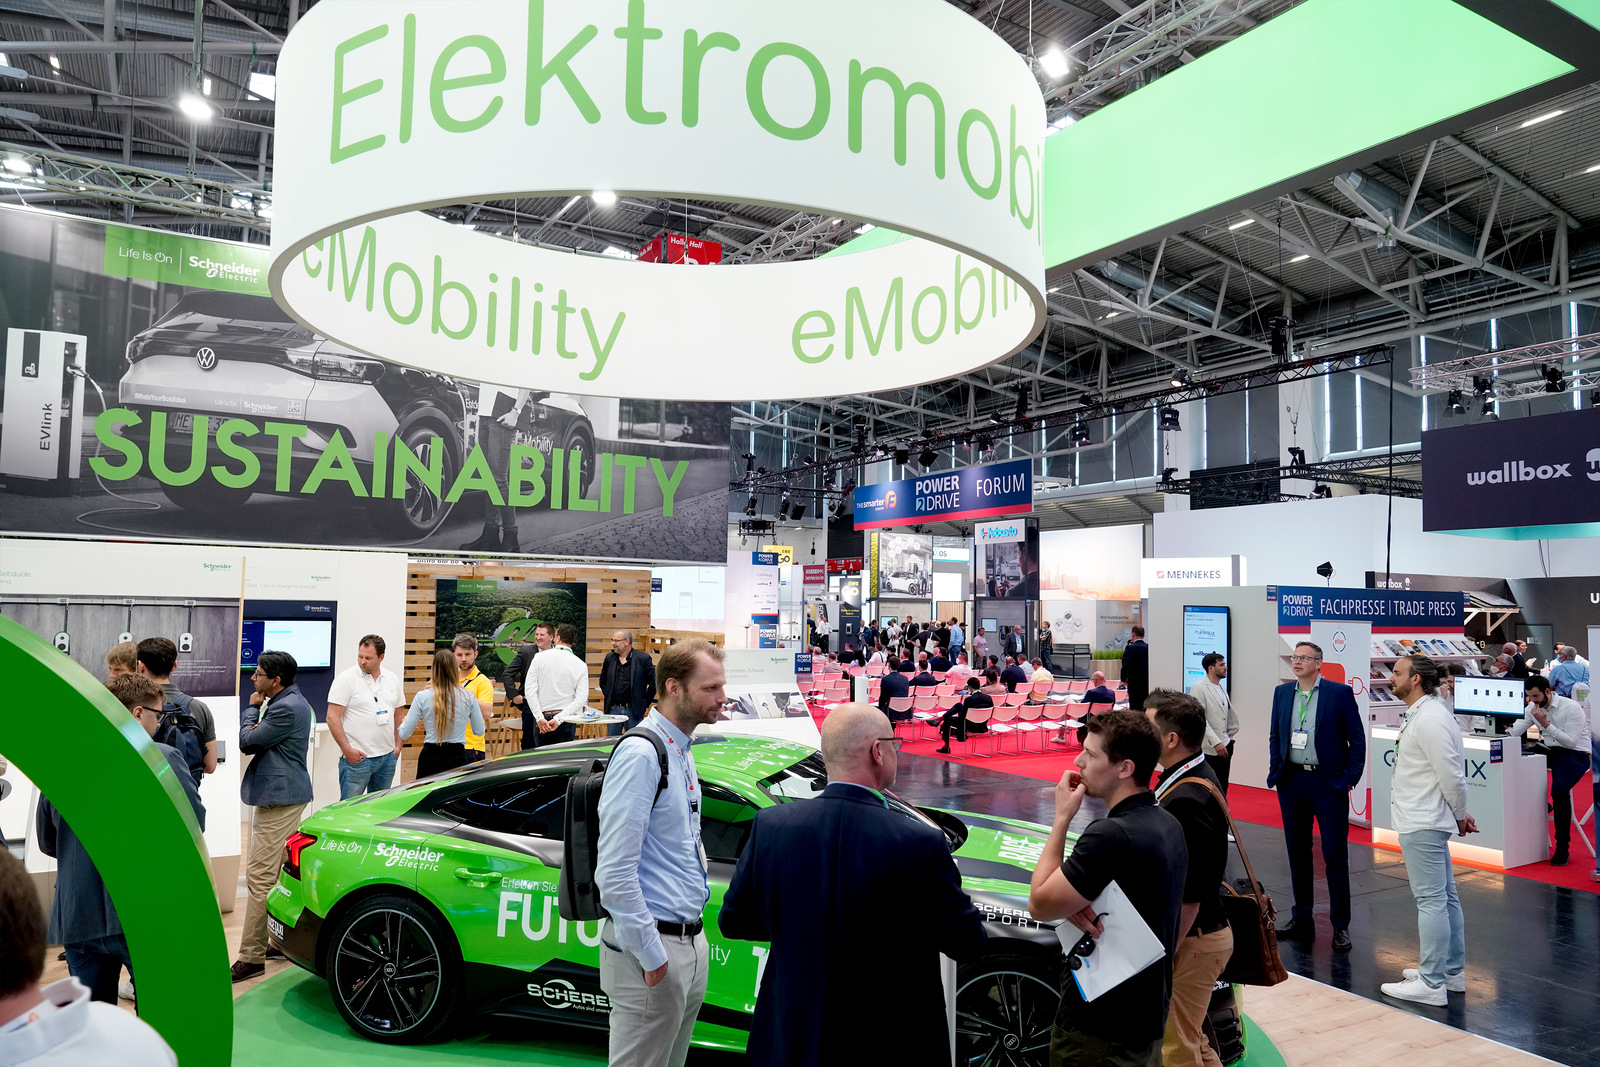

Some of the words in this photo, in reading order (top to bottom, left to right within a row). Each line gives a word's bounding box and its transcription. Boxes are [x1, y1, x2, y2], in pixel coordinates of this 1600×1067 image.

[689, 241, 703, 249] Hall
[119, 247, 140, 258] Life
[142, 250, 152, 260] Is
[154, 252, 173, 264] On
[189, 256, 260, 276] Schneider
[219, 271, 258, 283] Electric
[244, 401, 278, 411] Schneider
[40, 403, 53, 451] EVlink
[88, 408, 690, 517] SUSTAINABILITY
[1466, 460, 1572, 486] wallbox
[916, 475, 960, 496] POWER
[976, 473, 1025, 498] FORUM
[1167, 570, 1221, 579] MENNEKES
[1282, 594, 1313, 605] POWER
[1320, 598, 1386, 616] FACHPRESSE
[1394, 600, 1425, 616] TRADE
[1428, 601, 1456, 616] PRESS
[320, 840, 338, 850] Life
[337, 841, 346, 852] Is
[346, 841, 362, 854] On
[374, 842, 444, 862] Schneider
[398, 858, 439, 872] Electric
[502, 877, 539, 890] Erleben
[542, 881, 557, 892] Sie
